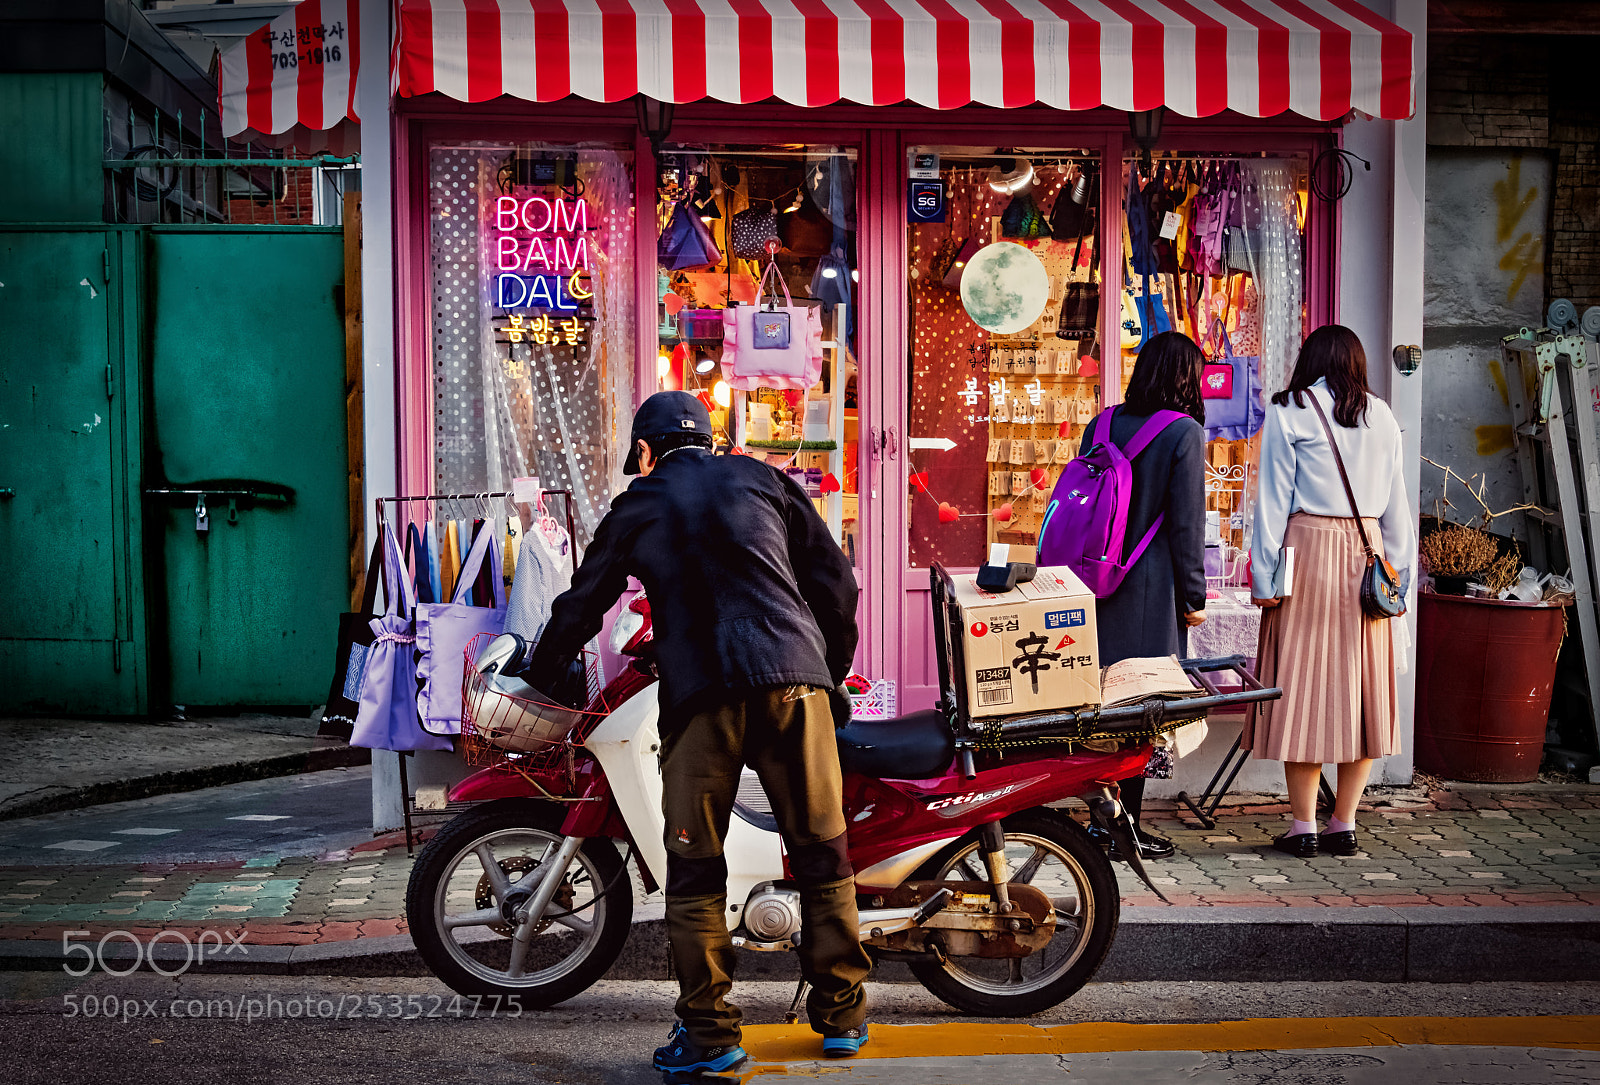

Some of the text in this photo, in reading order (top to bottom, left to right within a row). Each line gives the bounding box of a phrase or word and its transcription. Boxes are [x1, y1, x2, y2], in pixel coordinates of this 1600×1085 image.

[261, 21, 345, 50] 구산천막사
[271, 45, 342, 70] 703-1916
[918, 197, 936, 206] SG
[497, 196, 587, 233] BOM
[497, 236, 589, 272] BAM
[498, 273, 578, 310] DAL
[968, 356, 1000, 369] 당신이
[1048, 611, 1083, 626] 멀티팩
[989, 619, 1020, 634] 농심
[1063, 637, 1071, 645] 신
[1012, 631, 1061, 694] 辛
[1060, 655, 1093, 669] 라면
[977, 668, 1010, 681] 가3487
